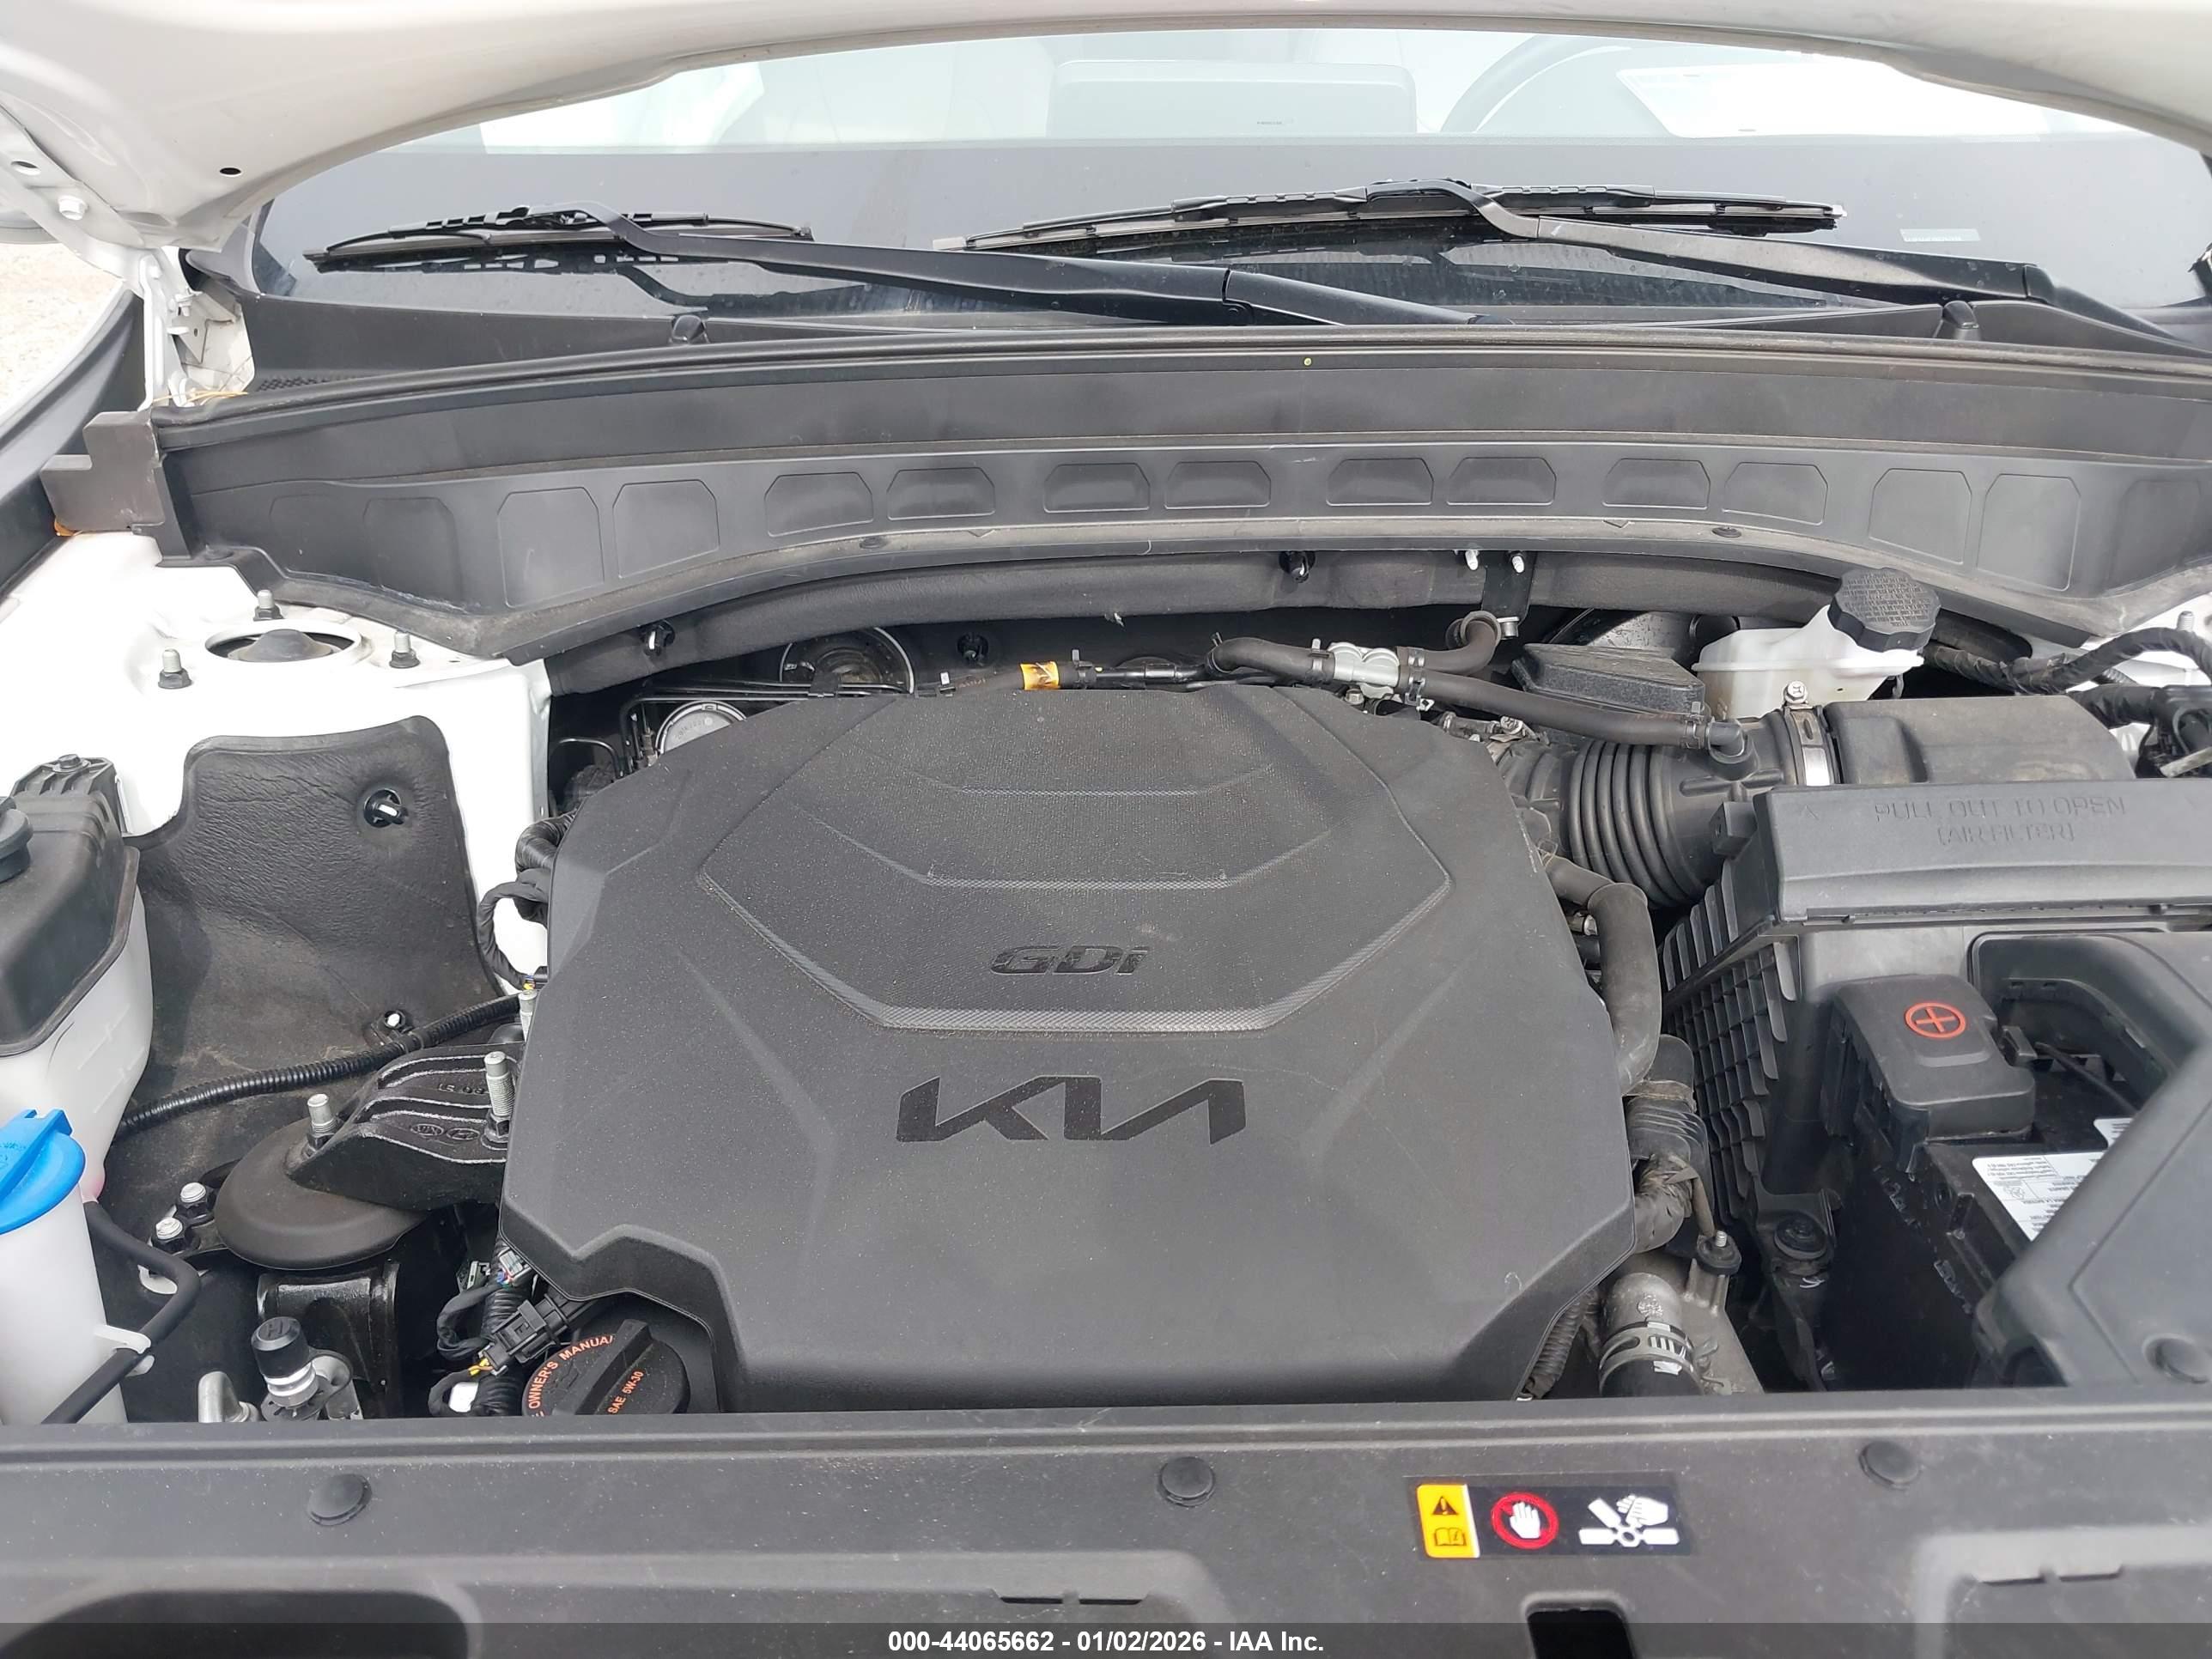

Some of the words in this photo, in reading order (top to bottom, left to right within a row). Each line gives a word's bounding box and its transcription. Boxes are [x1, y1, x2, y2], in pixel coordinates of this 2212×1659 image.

[1875, 801, 1932, 821] PULL
[1949, 799, 1999, 817] OUT
[2015, 799, 2045, 817] TO
[2053, 796, 2127, 816] OPEN
[896, 1074, 1247, 1146] KIA
[527, 1361, 559, 1410] OWNER'S
[607, 1395, 626, 1414] SAE
[622, 1370, 644, 1395] 5W-30
